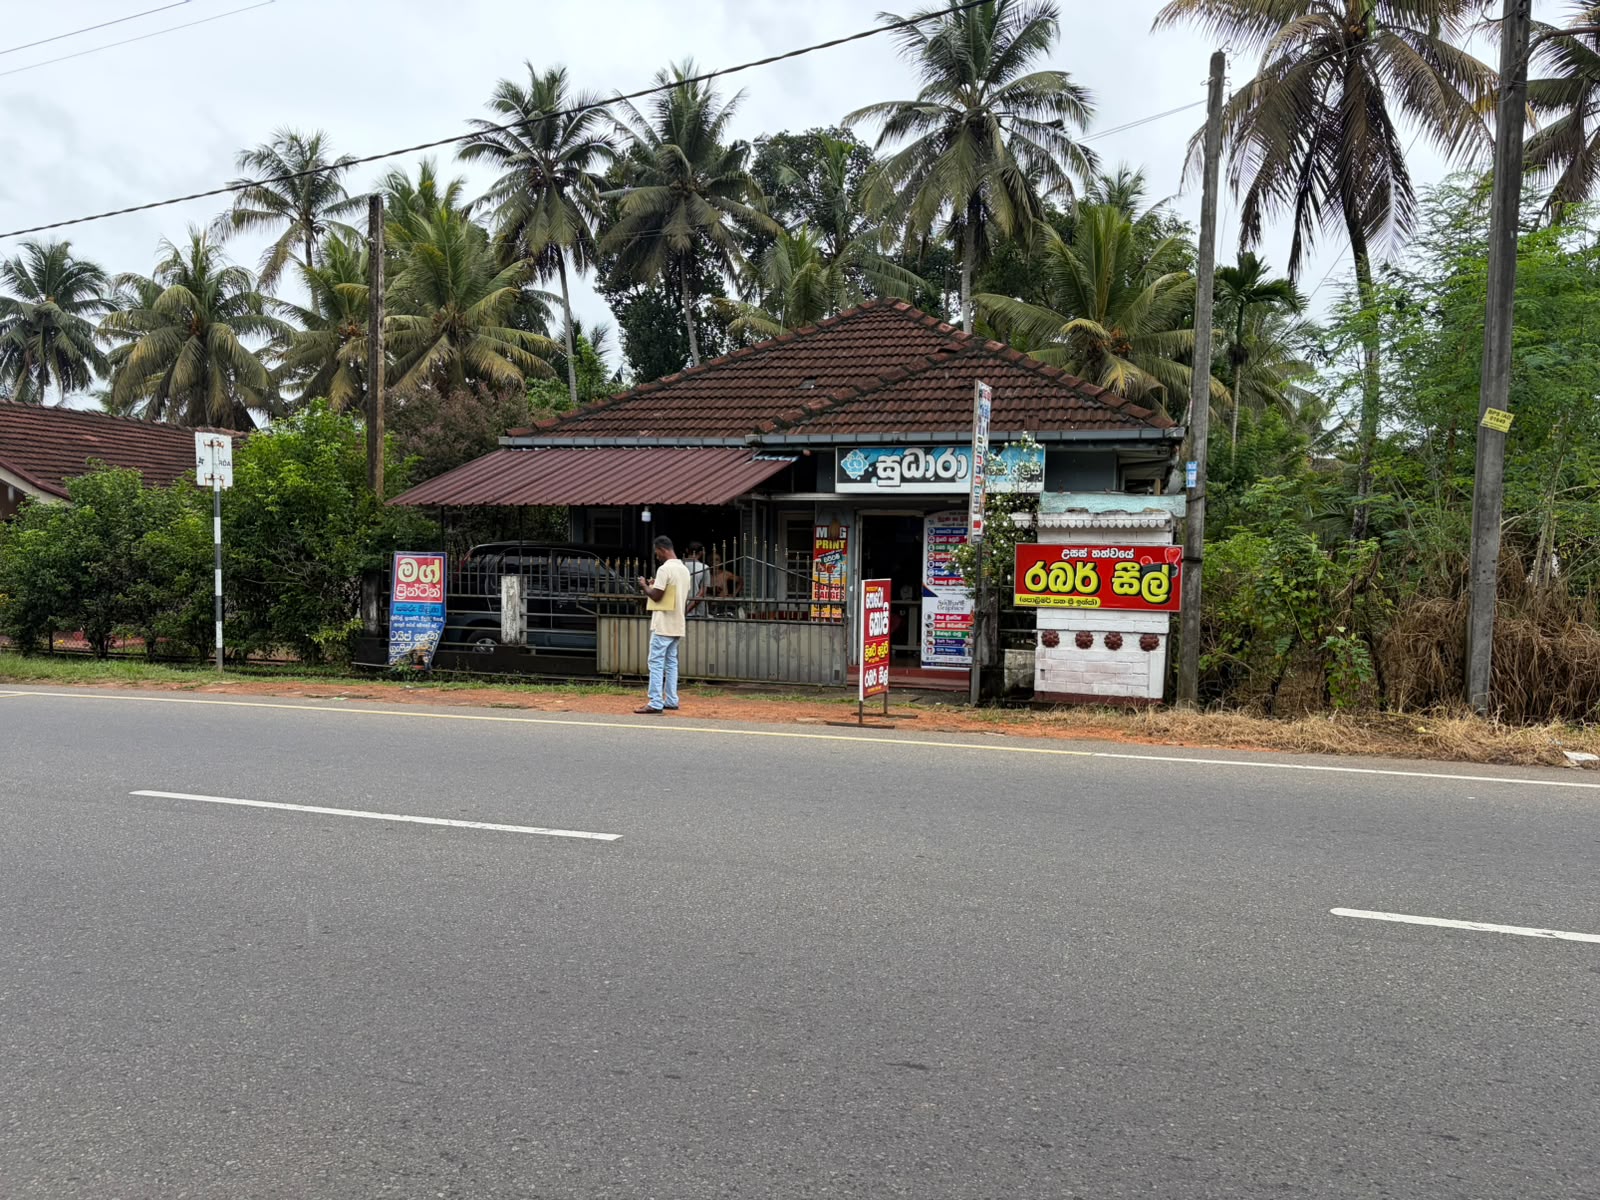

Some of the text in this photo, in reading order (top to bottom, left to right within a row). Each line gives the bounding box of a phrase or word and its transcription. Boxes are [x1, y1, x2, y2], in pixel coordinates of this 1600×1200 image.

[876, 447, 968, 487] සුධාරා
[815, 526, 847, 539] MG
[815, 539, 846, 549] PRINT
[1061, 547, 1087, 559] උසස්
[398, 558, 440, 583] මග්
[1025, 561, 1170, 603] රබර් සීල්
